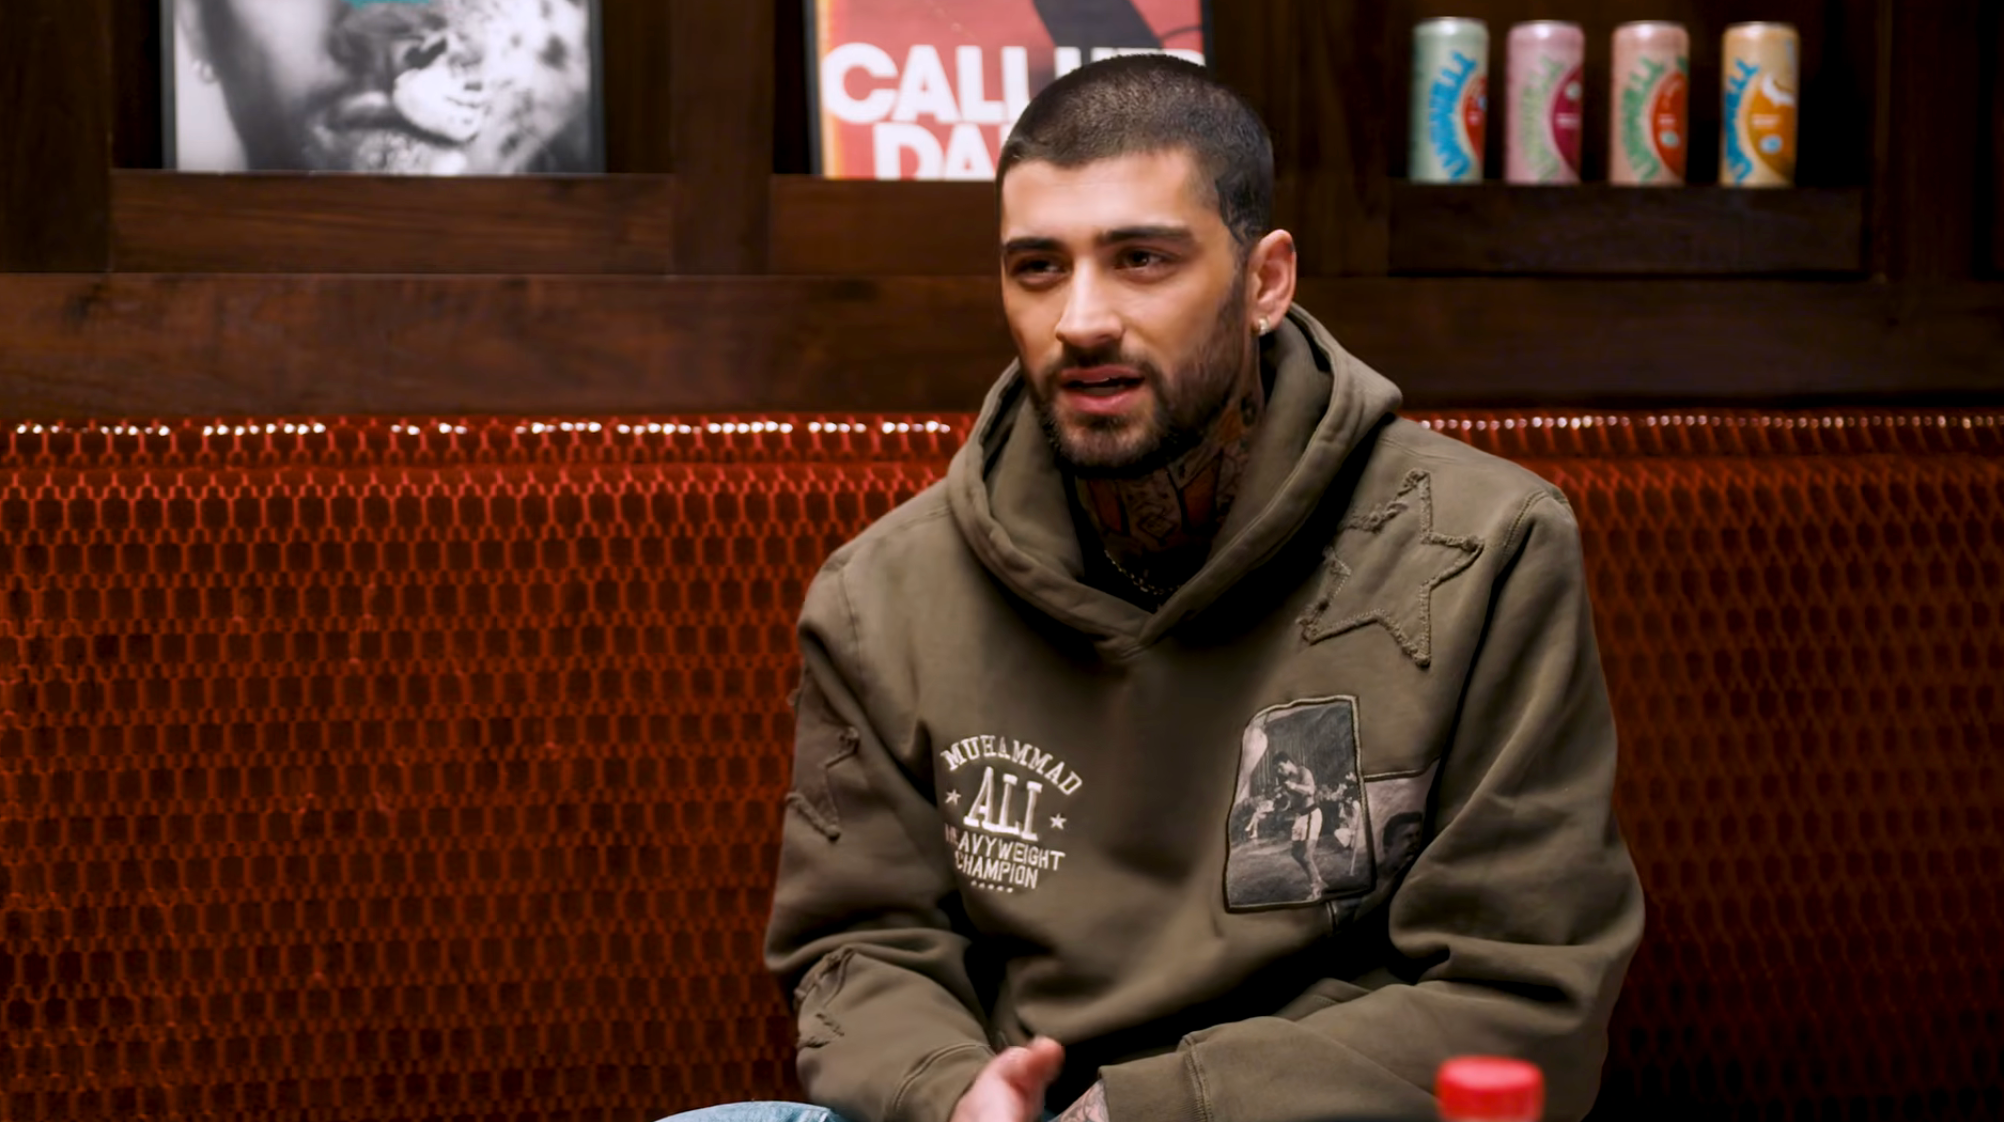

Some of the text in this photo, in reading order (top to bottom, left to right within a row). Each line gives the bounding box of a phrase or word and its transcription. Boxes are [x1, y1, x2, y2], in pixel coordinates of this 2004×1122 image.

[821, 43, 1029, 124] CALL
[872, 123, 1012, 180] DA
[940, 735, 1083, 795] MUHAMMAD
[963, 766, 1043, 841] ALI
[955, 850, 1039, 889] CHAMPION
